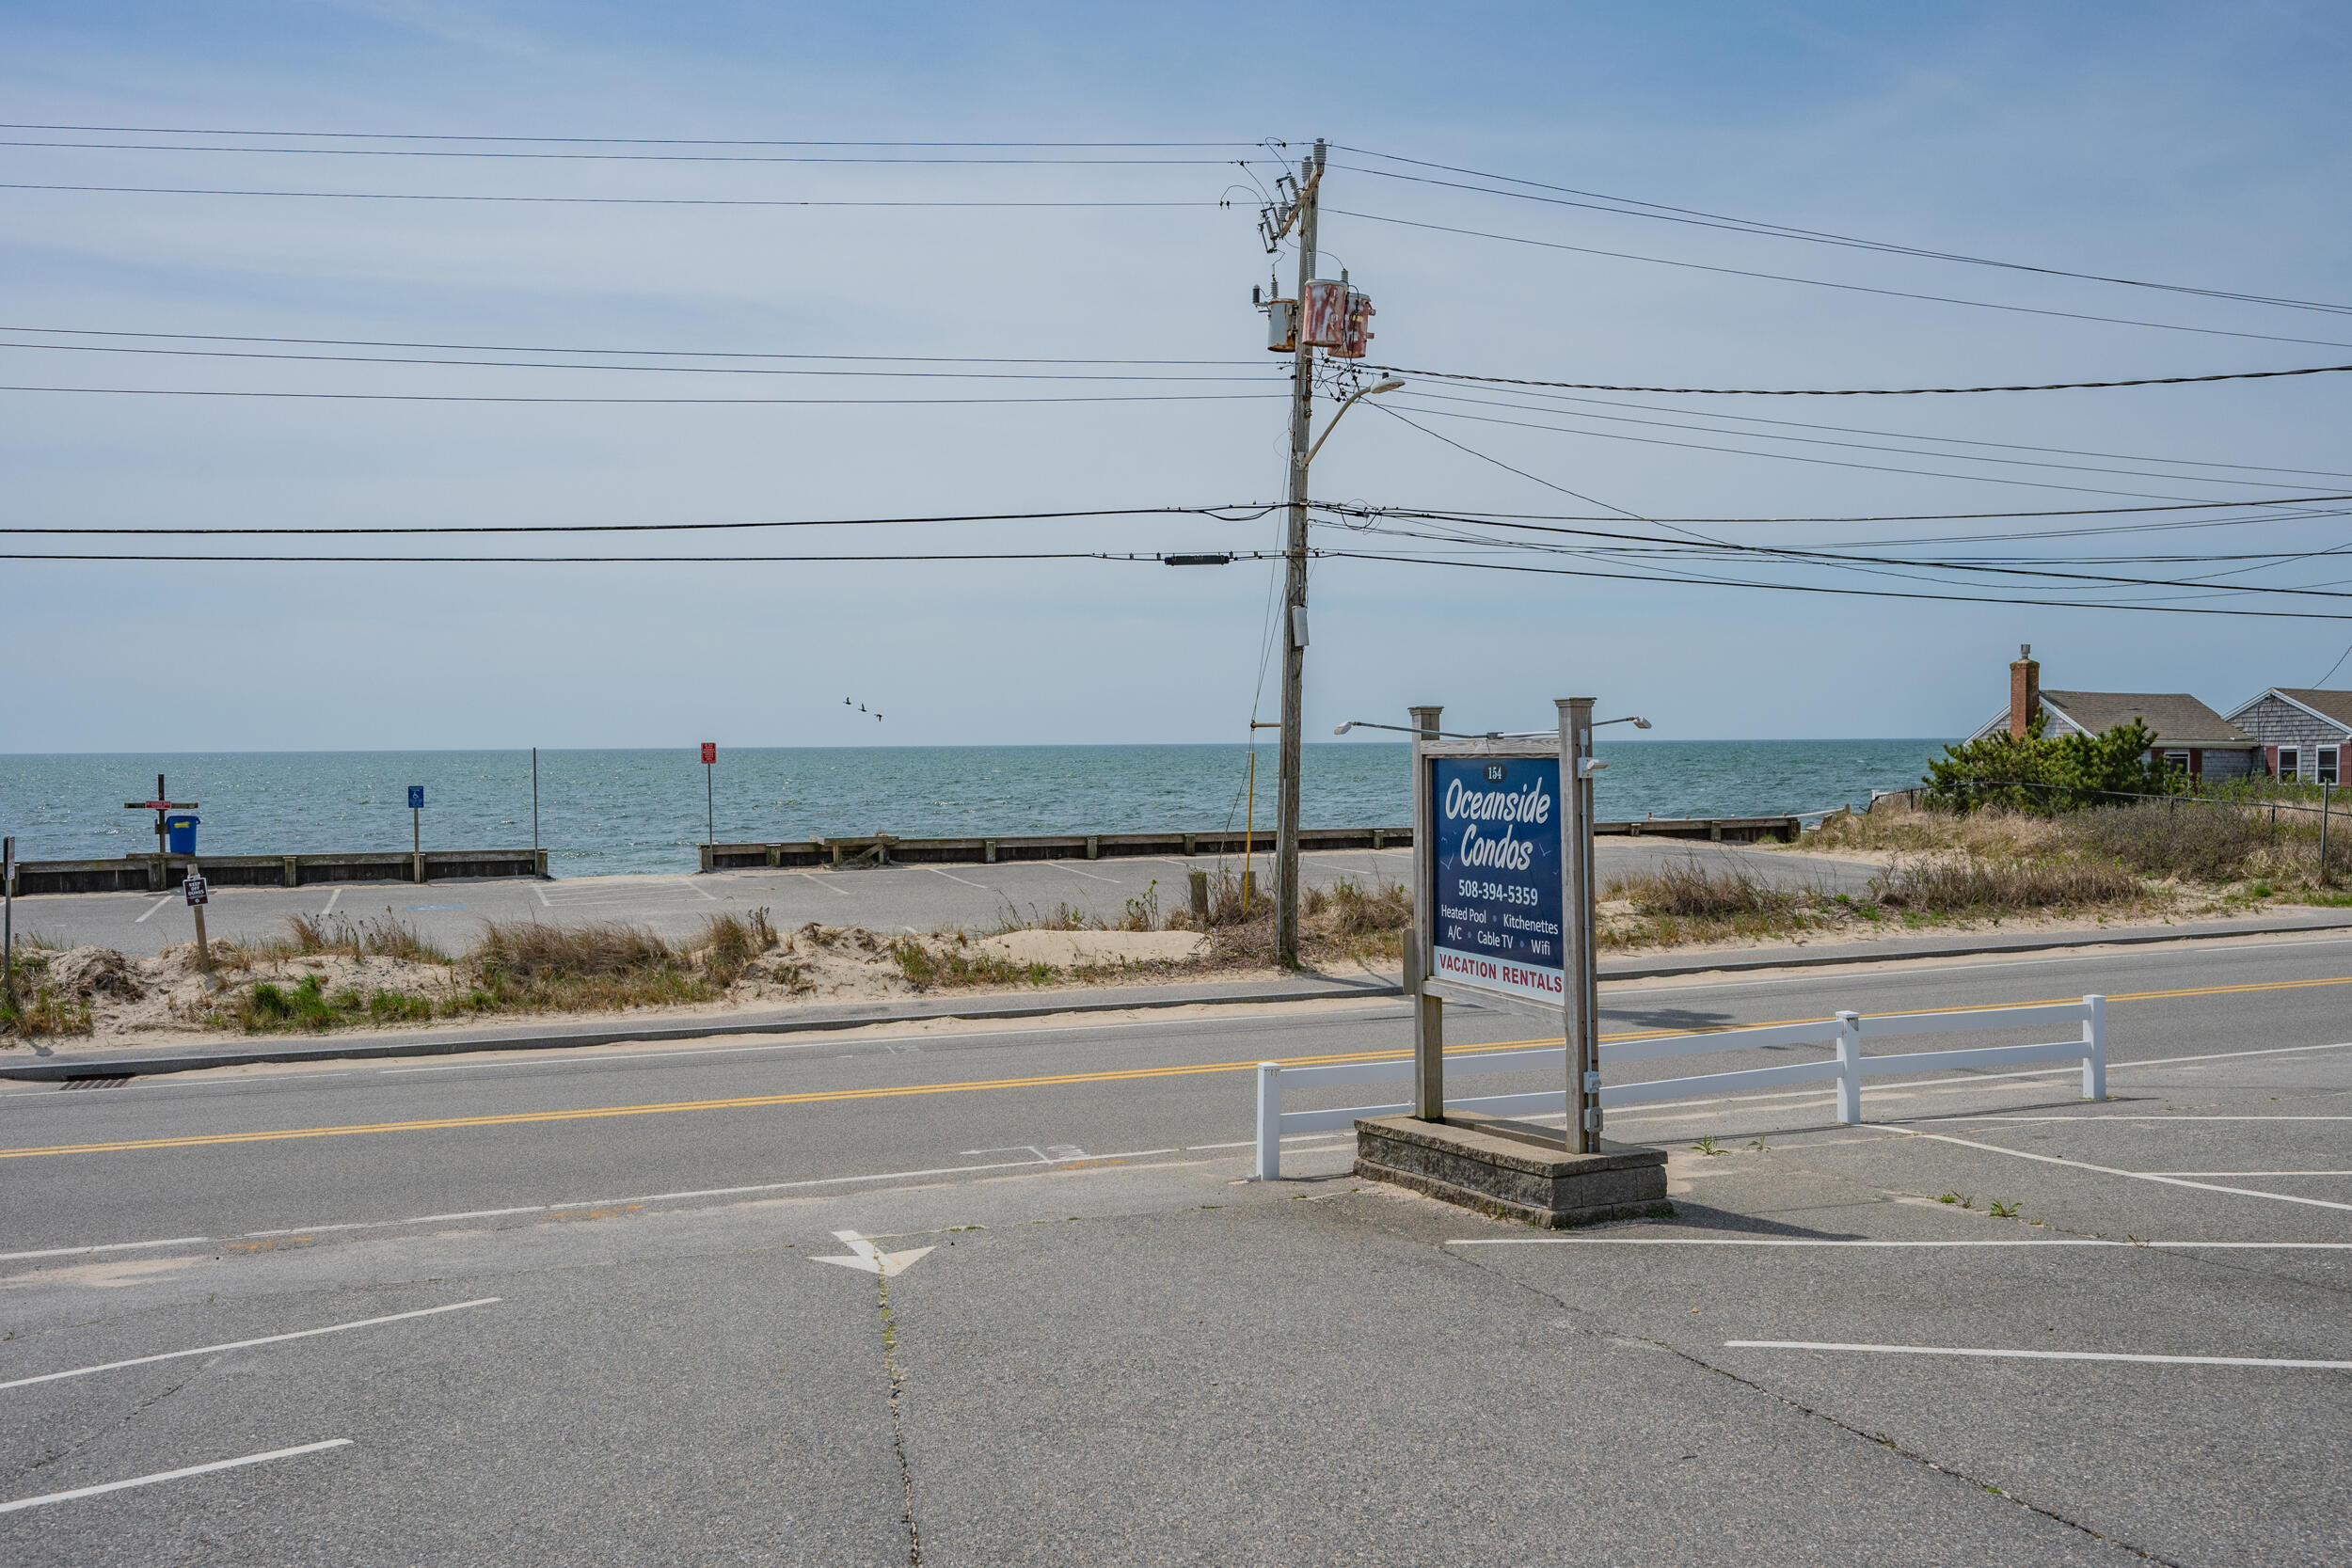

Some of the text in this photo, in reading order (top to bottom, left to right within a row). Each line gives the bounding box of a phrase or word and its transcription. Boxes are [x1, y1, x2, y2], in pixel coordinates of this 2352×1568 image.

[1488, 767, 1502, 780] 154
[1445, 776, 1550, 824] Oceanside
[1460, 823, 1534, 870] Condos
[1458, 879, 1538, 906] 508-394-5359
[1440, 904, 1559, 935] Heated Pool Kitchenettes
[1448, 925, 1550, 956] A/C Cable TV Wifi
[1439, 953, 1563, 993] VACATION RENTALS
